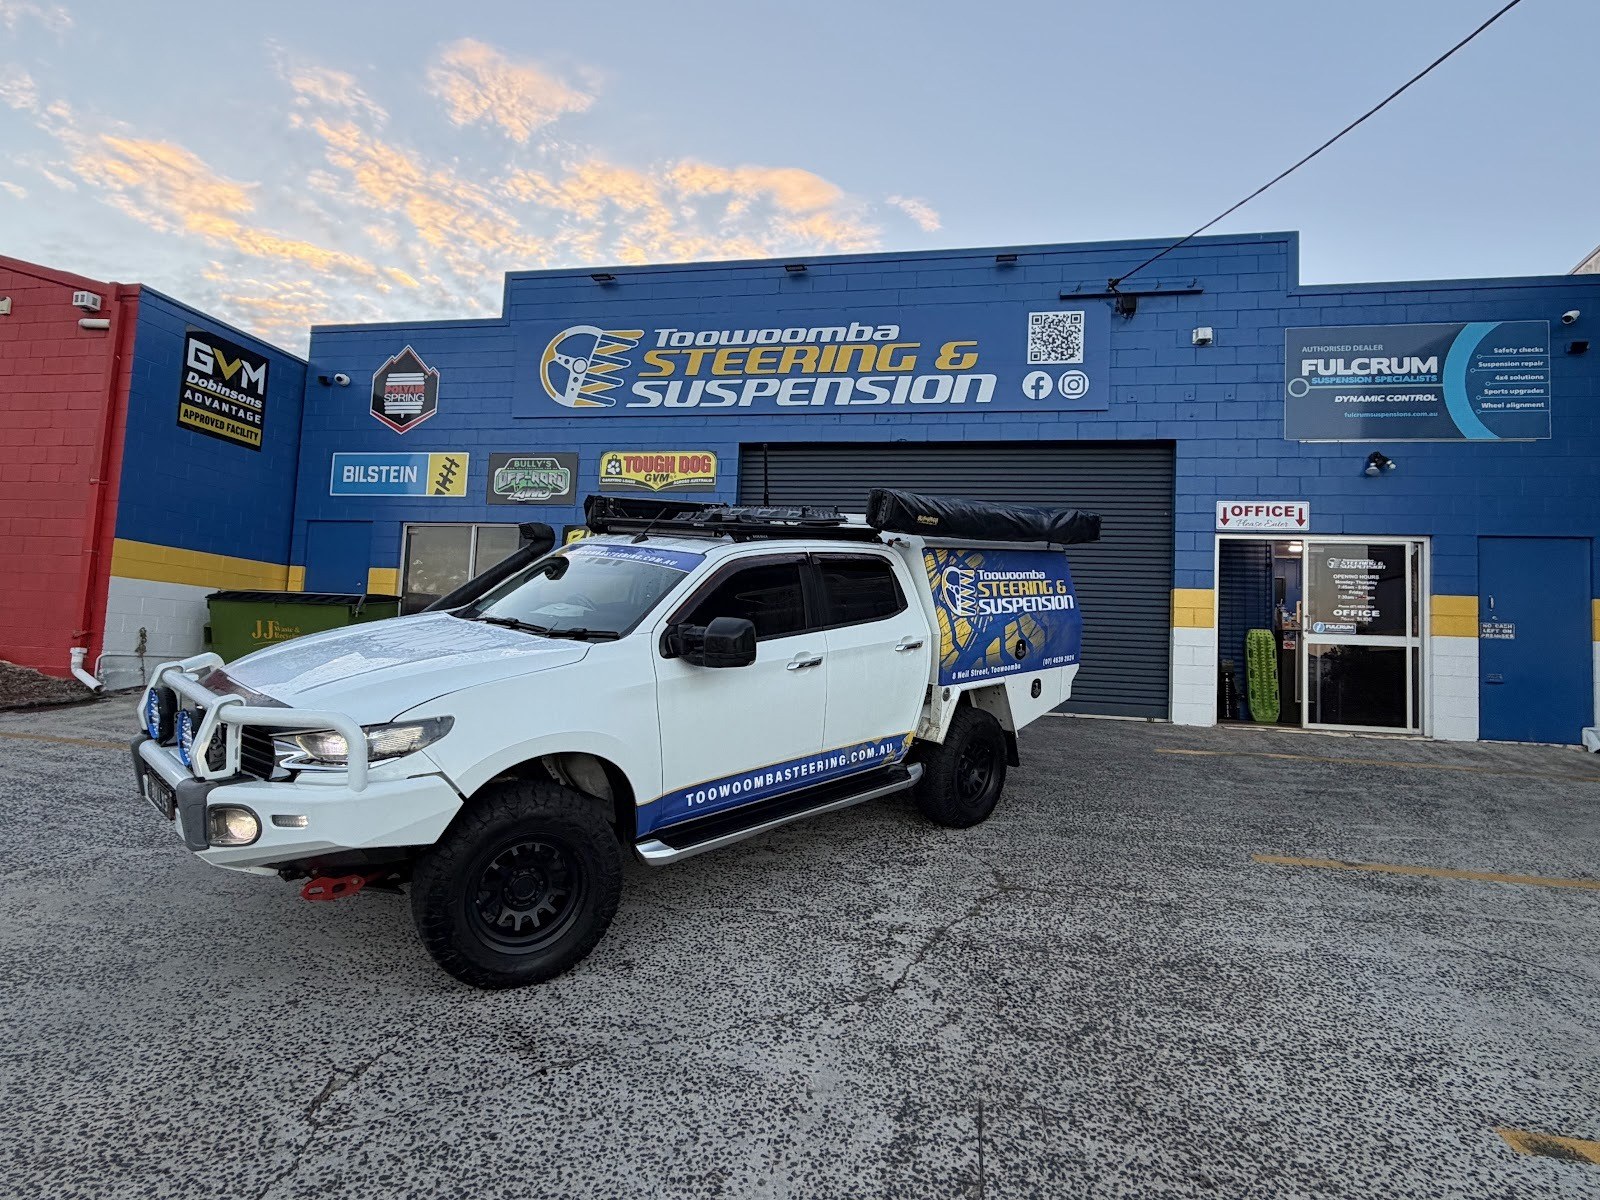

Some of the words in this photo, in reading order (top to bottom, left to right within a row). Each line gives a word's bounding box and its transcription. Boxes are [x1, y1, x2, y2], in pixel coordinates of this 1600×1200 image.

[655, 322, 900, 348] Toowoomba
[1302, 345, 1352, 353] AUTHORISED
[1353, 344, 1384, 352] DEALER
[187, 338, 266, 395] GVM
[638, 342, 921, 377] STEERING
[935, 341, 979, 371] &
[1301, 356, 1437, 377] FULCRUM
[1311, 376, 1372, 384] SUSPENSION
[1374, 375, 1437, 383] SPECIALISTS
[186, 371, 263, 408] Dobinsons
[384, 393, 425, 402] SPRING
[625, 374, 998, 408] SUSPENSION
[184, 389, 262, 425] ADVANTAGE
[1335, 395, 1385, 403] DYNAMIC
[1385, 394, 1437, 402] CONTROL
[183, 408, 225, 431] APPROVED
[226, 422, 259, 441] FACILITY
[514, 460, 552, 468] BULLY'S
[623, 455, 676, 474] TOUGH
[678, 455, 712, 474] DOG
[342, 466, 418, 483] BILSTEIN
[644, 474, 670, 482] GVM
[1230, 505, 1295, 518] OFFICE
[1236, 519, 1261, 528] Please
[1264, 519, 1289, 528] Enter
[977, 569, 1046, 581] Toowoomba
[977, 580, 1053, 598] STEERING
[1056, 580, 1067, 594] &
[978, 595, 1075, 616] SUSPENSION
[1333, 609, 1380, 617] OFFICE
[957, 670, 970, 680] Neil
[970, 668, 990, 677] Street,
[991, 663, 1021, 674] Toowoomba
[685, 743, 894, 807] TOOWOOMBASTEERING.COM.AU
